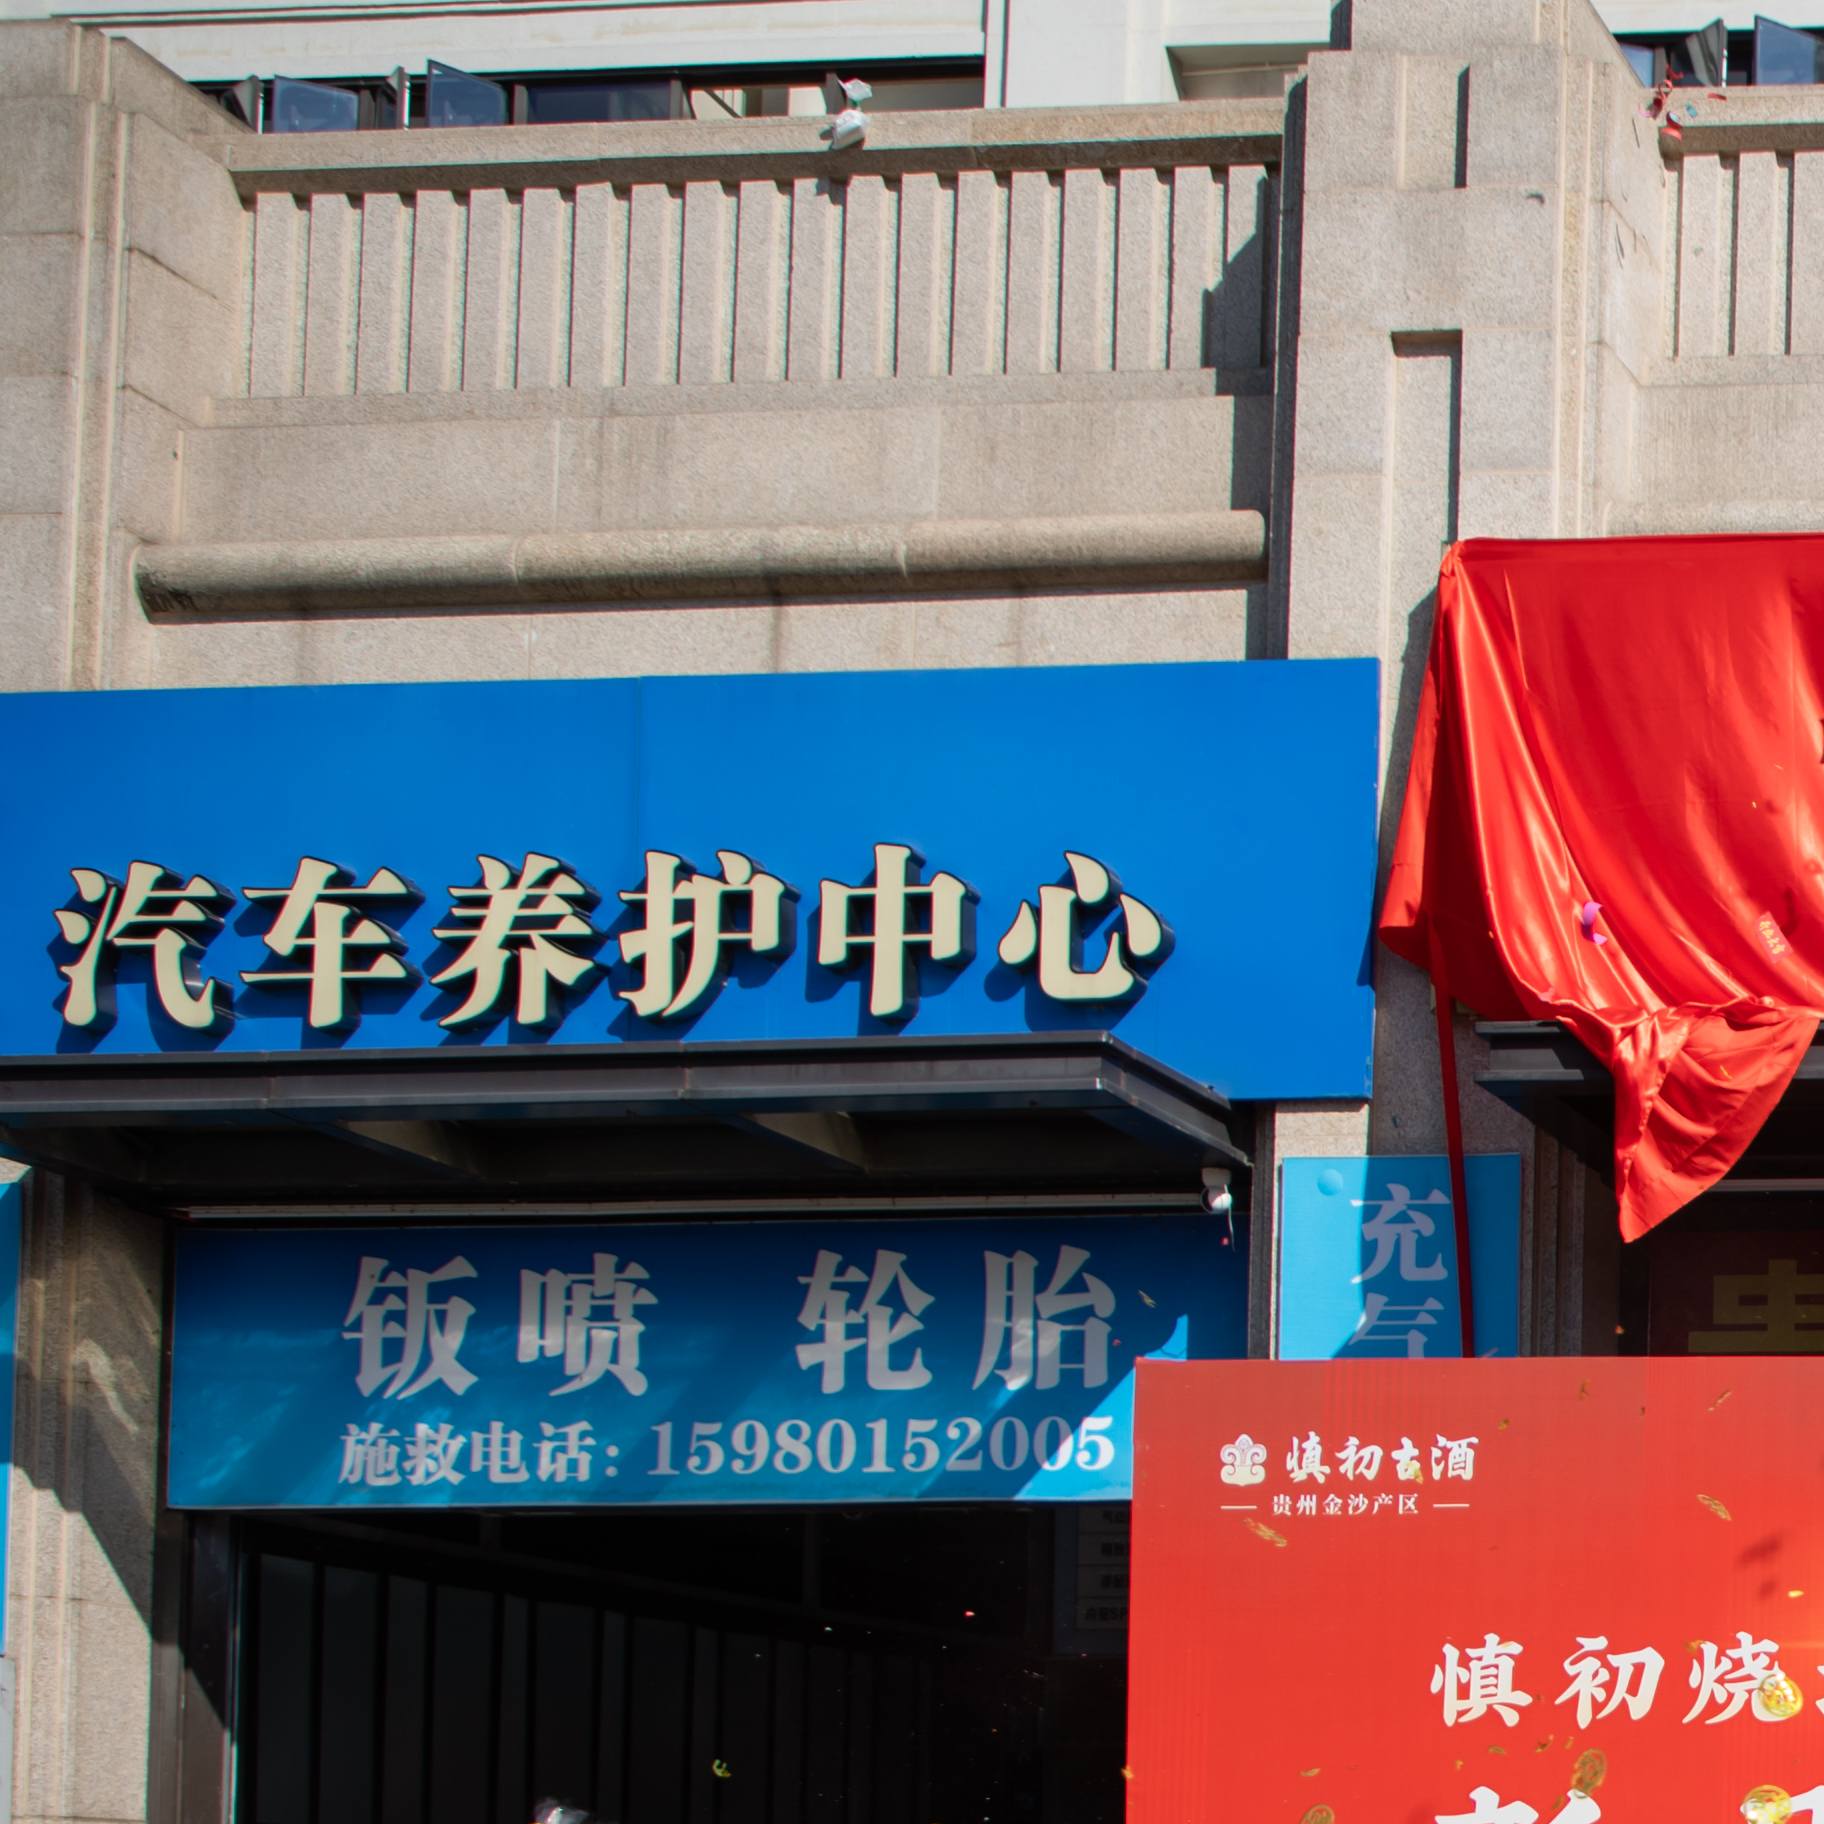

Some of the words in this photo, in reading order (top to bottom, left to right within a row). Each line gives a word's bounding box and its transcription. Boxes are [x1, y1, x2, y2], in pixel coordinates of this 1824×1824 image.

[53, 841, 1163, 1029] 汽车养护中心
[341, 1251, 659, 1400] 钣喷
[797, 1244, 1118, 1392] 轮胎
[646, 1415, 1115, 1476] 15980152005
[1286, 1430, 1479, 1484] 慎初古酒
[1272, 1493, 1419, 1516] 贵州金沙产区
